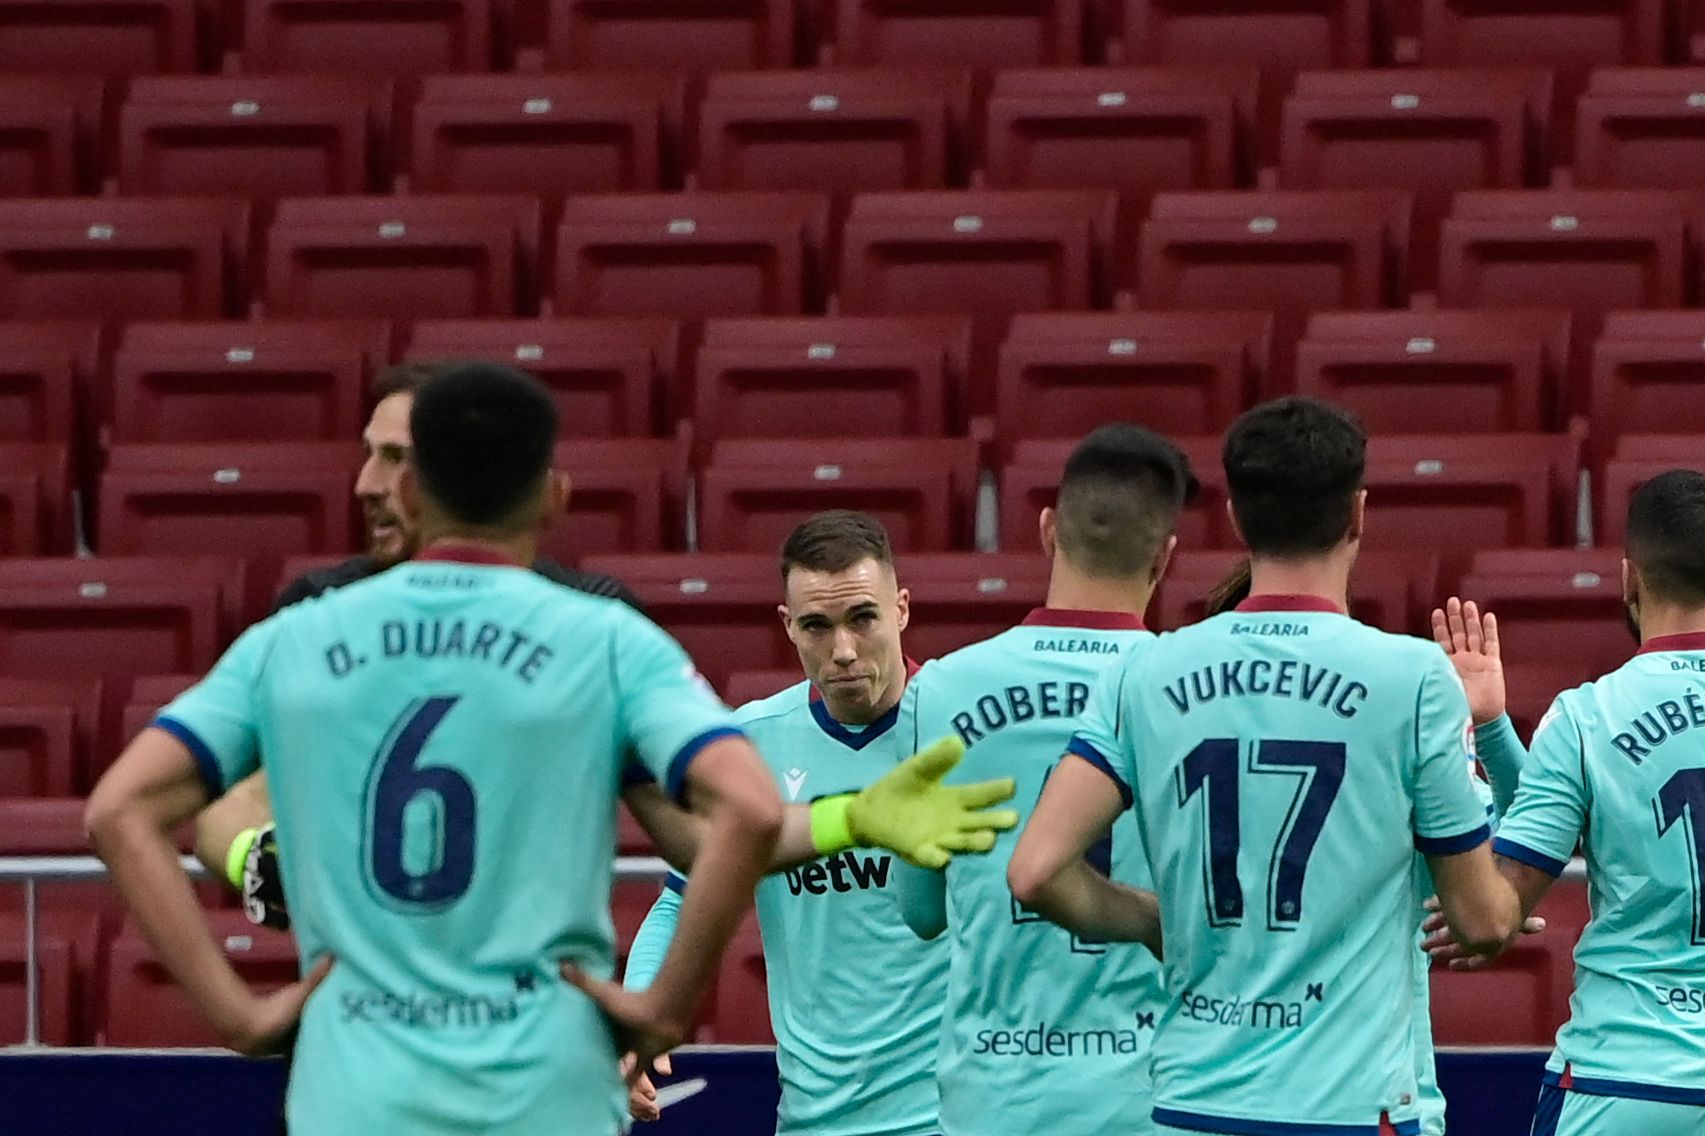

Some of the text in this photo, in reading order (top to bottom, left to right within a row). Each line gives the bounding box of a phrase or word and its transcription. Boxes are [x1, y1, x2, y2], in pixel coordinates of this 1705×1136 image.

[382, 620, 553, 683] DUARTE
[951, 681, 1090, 749] ROBER
[1163, 660, 1368, 719] VUKCEVIC
[360, 695, 477, 916] 6
[1174, 737, 1347, 931] 17
[973, 1022, 1137, 1056] sesderma
